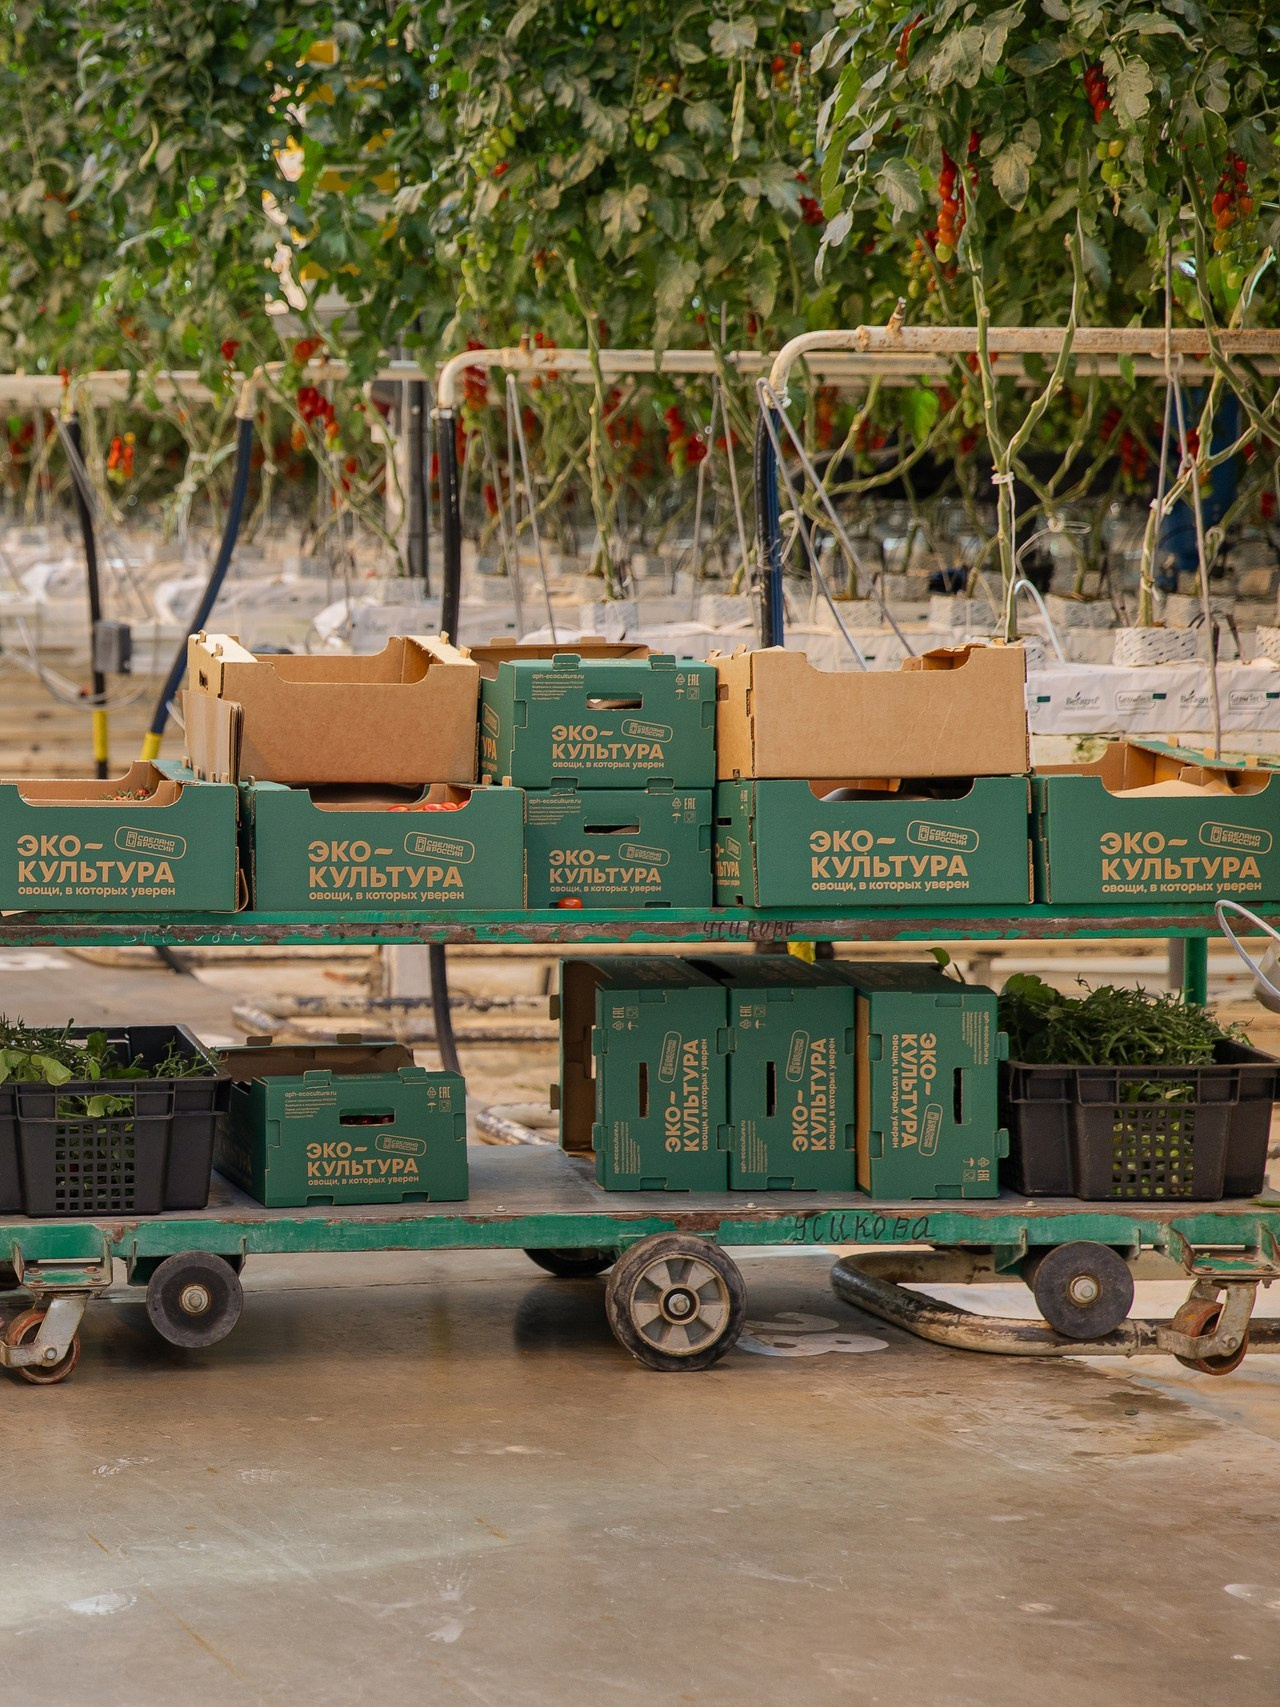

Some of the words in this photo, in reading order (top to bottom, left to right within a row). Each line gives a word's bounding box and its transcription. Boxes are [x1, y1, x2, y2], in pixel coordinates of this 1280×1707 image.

[552, 743, 664, 760] КУЛЬТУРА
[593, 761, 631, 770] которых
[632, 761, 664, 770] уверен
[137, 835, 175, 847] СДЕЛАНО
[930, 829, 968, 840] СДЕЛАНО
[1222, 830, 1261, 841] СДЕЛАНО
[427, 840, 464, 852] СДЕЛАНО
[17, 860, 175, 884] КУЛЬТУРА
[549, 867, 661, 884] КУЛЬТУРА
[716, 861, 740, 877] ЬТУРА
[811, 855, 968, 878] КУЛЬТУРА
[1102, 856, 1261, 880] КУЛЬТУРА
[309, 866, 464, 888] КУЛЬТУРА
[812, 881, 856, 891] овощи,
[859, 881, 866, 890] в
[869, 880, 922, 892] которых
[924, 880, 969, 891] уверен
[17, 886, 63, 897] овощи,
[65, 886, 73, 896] в
[75, 886, 129, 898] которых
[131, 886, 176, 898] уверен
[309, 891, 353, 901] овощи,
[356, 892, 363, 900] в
[365, 891, 418, 902] которых
[420, 891, 465, 902] уверен
[550, 886, 581, 894] овощи,
[590, 886, 628, 894] которых
[630, 886, 662, 894] уверен
[1102, 883, 1147, 894] овощи,
[1150, 884, 1157, 892] в
[1160, 883, 1213, 894] которых
[1216, 882, 1262, 893] уверен
[702, 1039, 710, 1071] уверен
[829, 1038, 837, 1070] уверен
[683, 1039, 699, 1152] КУЛЬТУРА
[702, 1072, 710, 1110] которых
[811, 1038, 827, 1150] КУЛЬТУРА
[829, 1072, 837, 1109] которых
[891, 1075, 899, 1113] которых
[901, 1034, 918, 1148] КУЛЬТУРА
[890, 1115, 899, 1148] уверен
[308, 1158, 419, 1177] КУЛЬТУРА
[349, 1177, 385, 1186] которых
[388, 1175, 419, 1185] уверен
